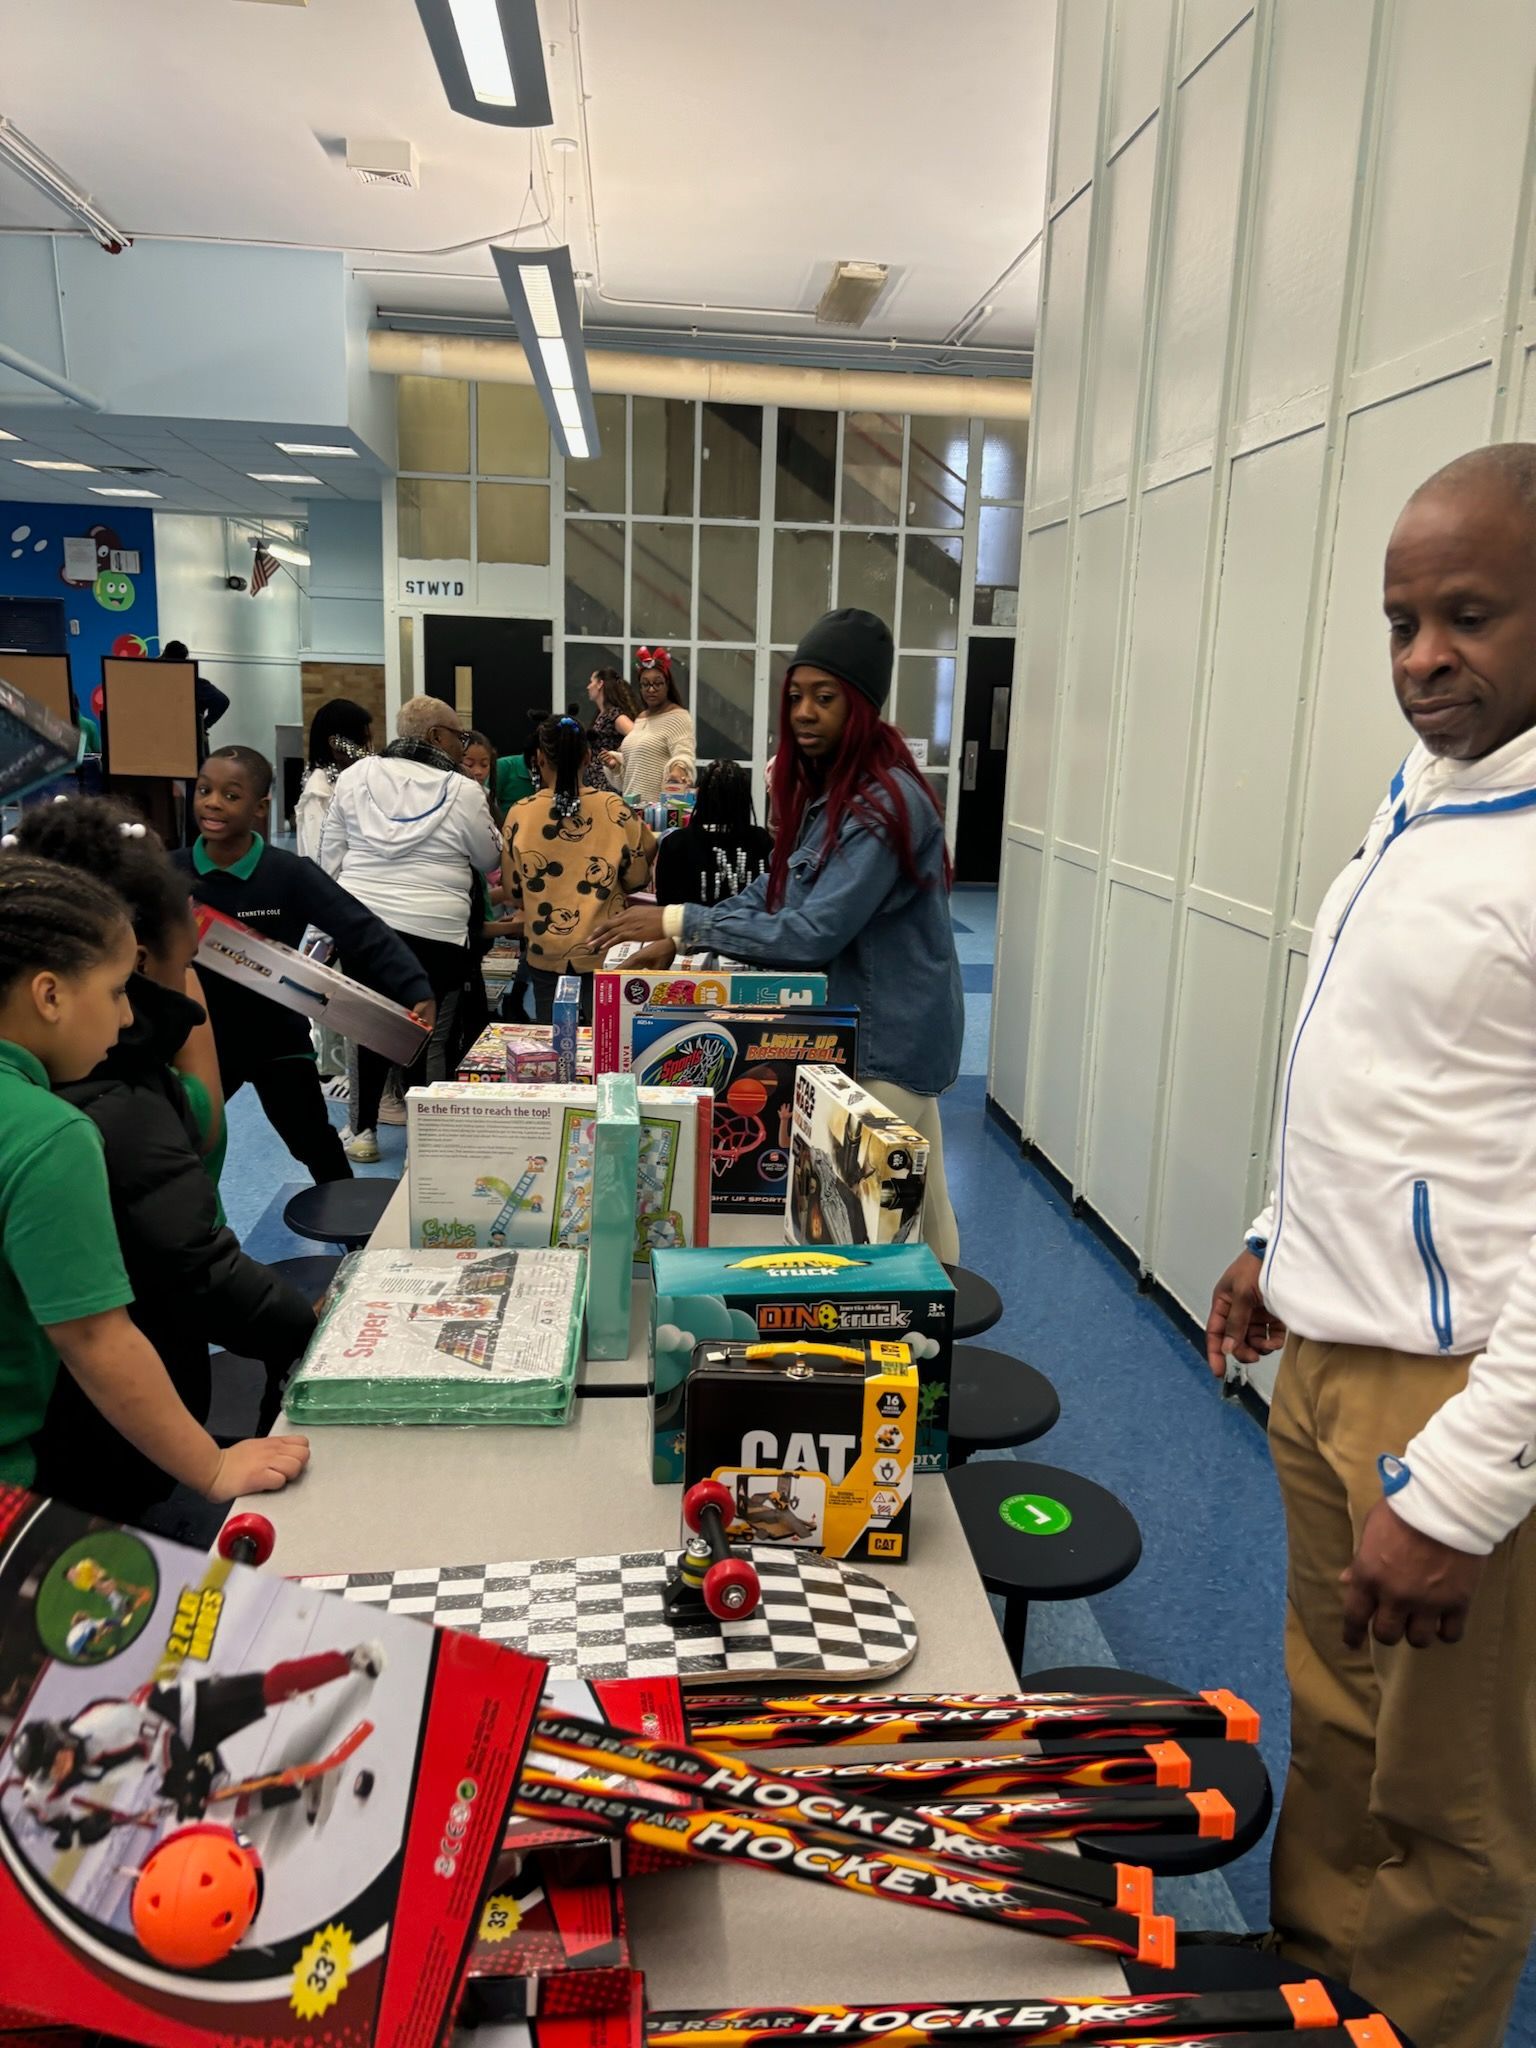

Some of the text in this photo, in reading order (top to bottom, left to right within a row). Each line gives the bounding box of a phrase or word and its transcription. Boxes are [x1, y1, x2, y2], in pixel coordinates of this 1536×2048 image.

[406, 580, 464, 596] STWYD
[760, 1032, 838, 1049] LIGHT-UP
[745, 1045, 847, 1064] BASKETBALL
[417, 1103, 551, 1118] Be the first to reach the top!
[422, 1218, 477, 1240] Chutes
[767, 1267, 839, 1277] truck
[838, 1303, 908, 1328] truck
[928, 1303, 945, 1312] 3+
[343, 1311, 389, 1358] Super
[885, 1394, 900, 1406] 16
[740, 1429, 856, 1487] CAT
[874, 1538, 897, 1551] CAT
[815, 1693, 1044, 1704] HOCKEY
[818, 1709, 1054, 1725] HOCKEY
[537, 1720, 701, 1775] UPERSTAR
[702, 1766, 972, 1853] HOCKEY
[517, 1782, 692, 1832] UPERSTAR
[692, 1821, 978, 1902] HOCKEY
[645, 2004, 1094, 2035] PERSTAR HOCKEY
